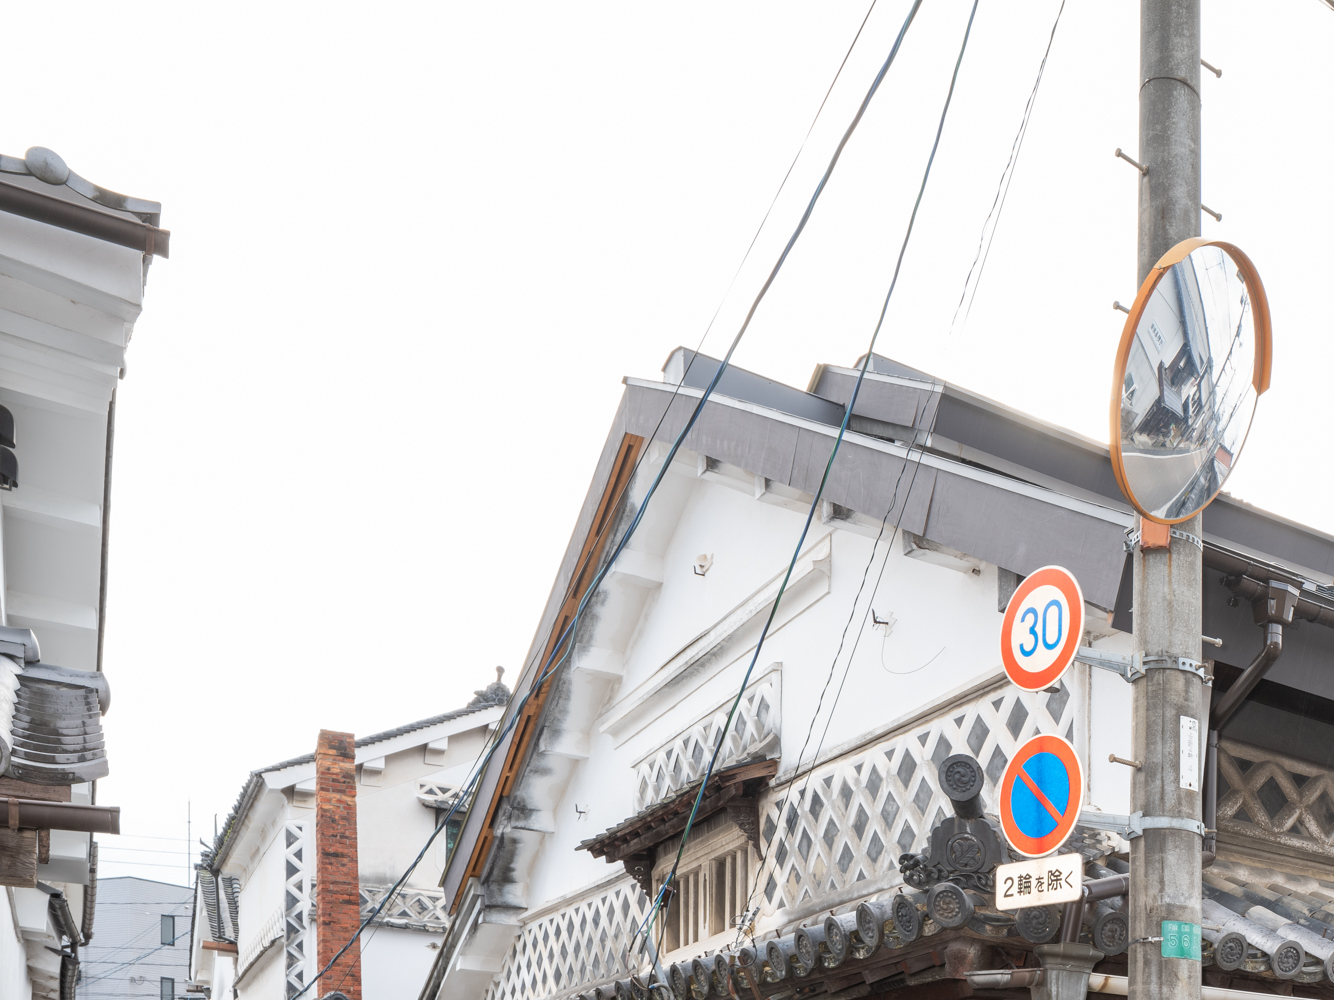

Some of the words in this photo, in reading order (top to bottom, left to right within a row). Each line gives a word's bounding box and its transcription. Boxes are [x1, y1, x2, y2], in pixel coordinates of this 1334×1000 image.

[1019, 599, 1062, 657] 30
[1003, 868, 1073, 898] 2輪を除く
